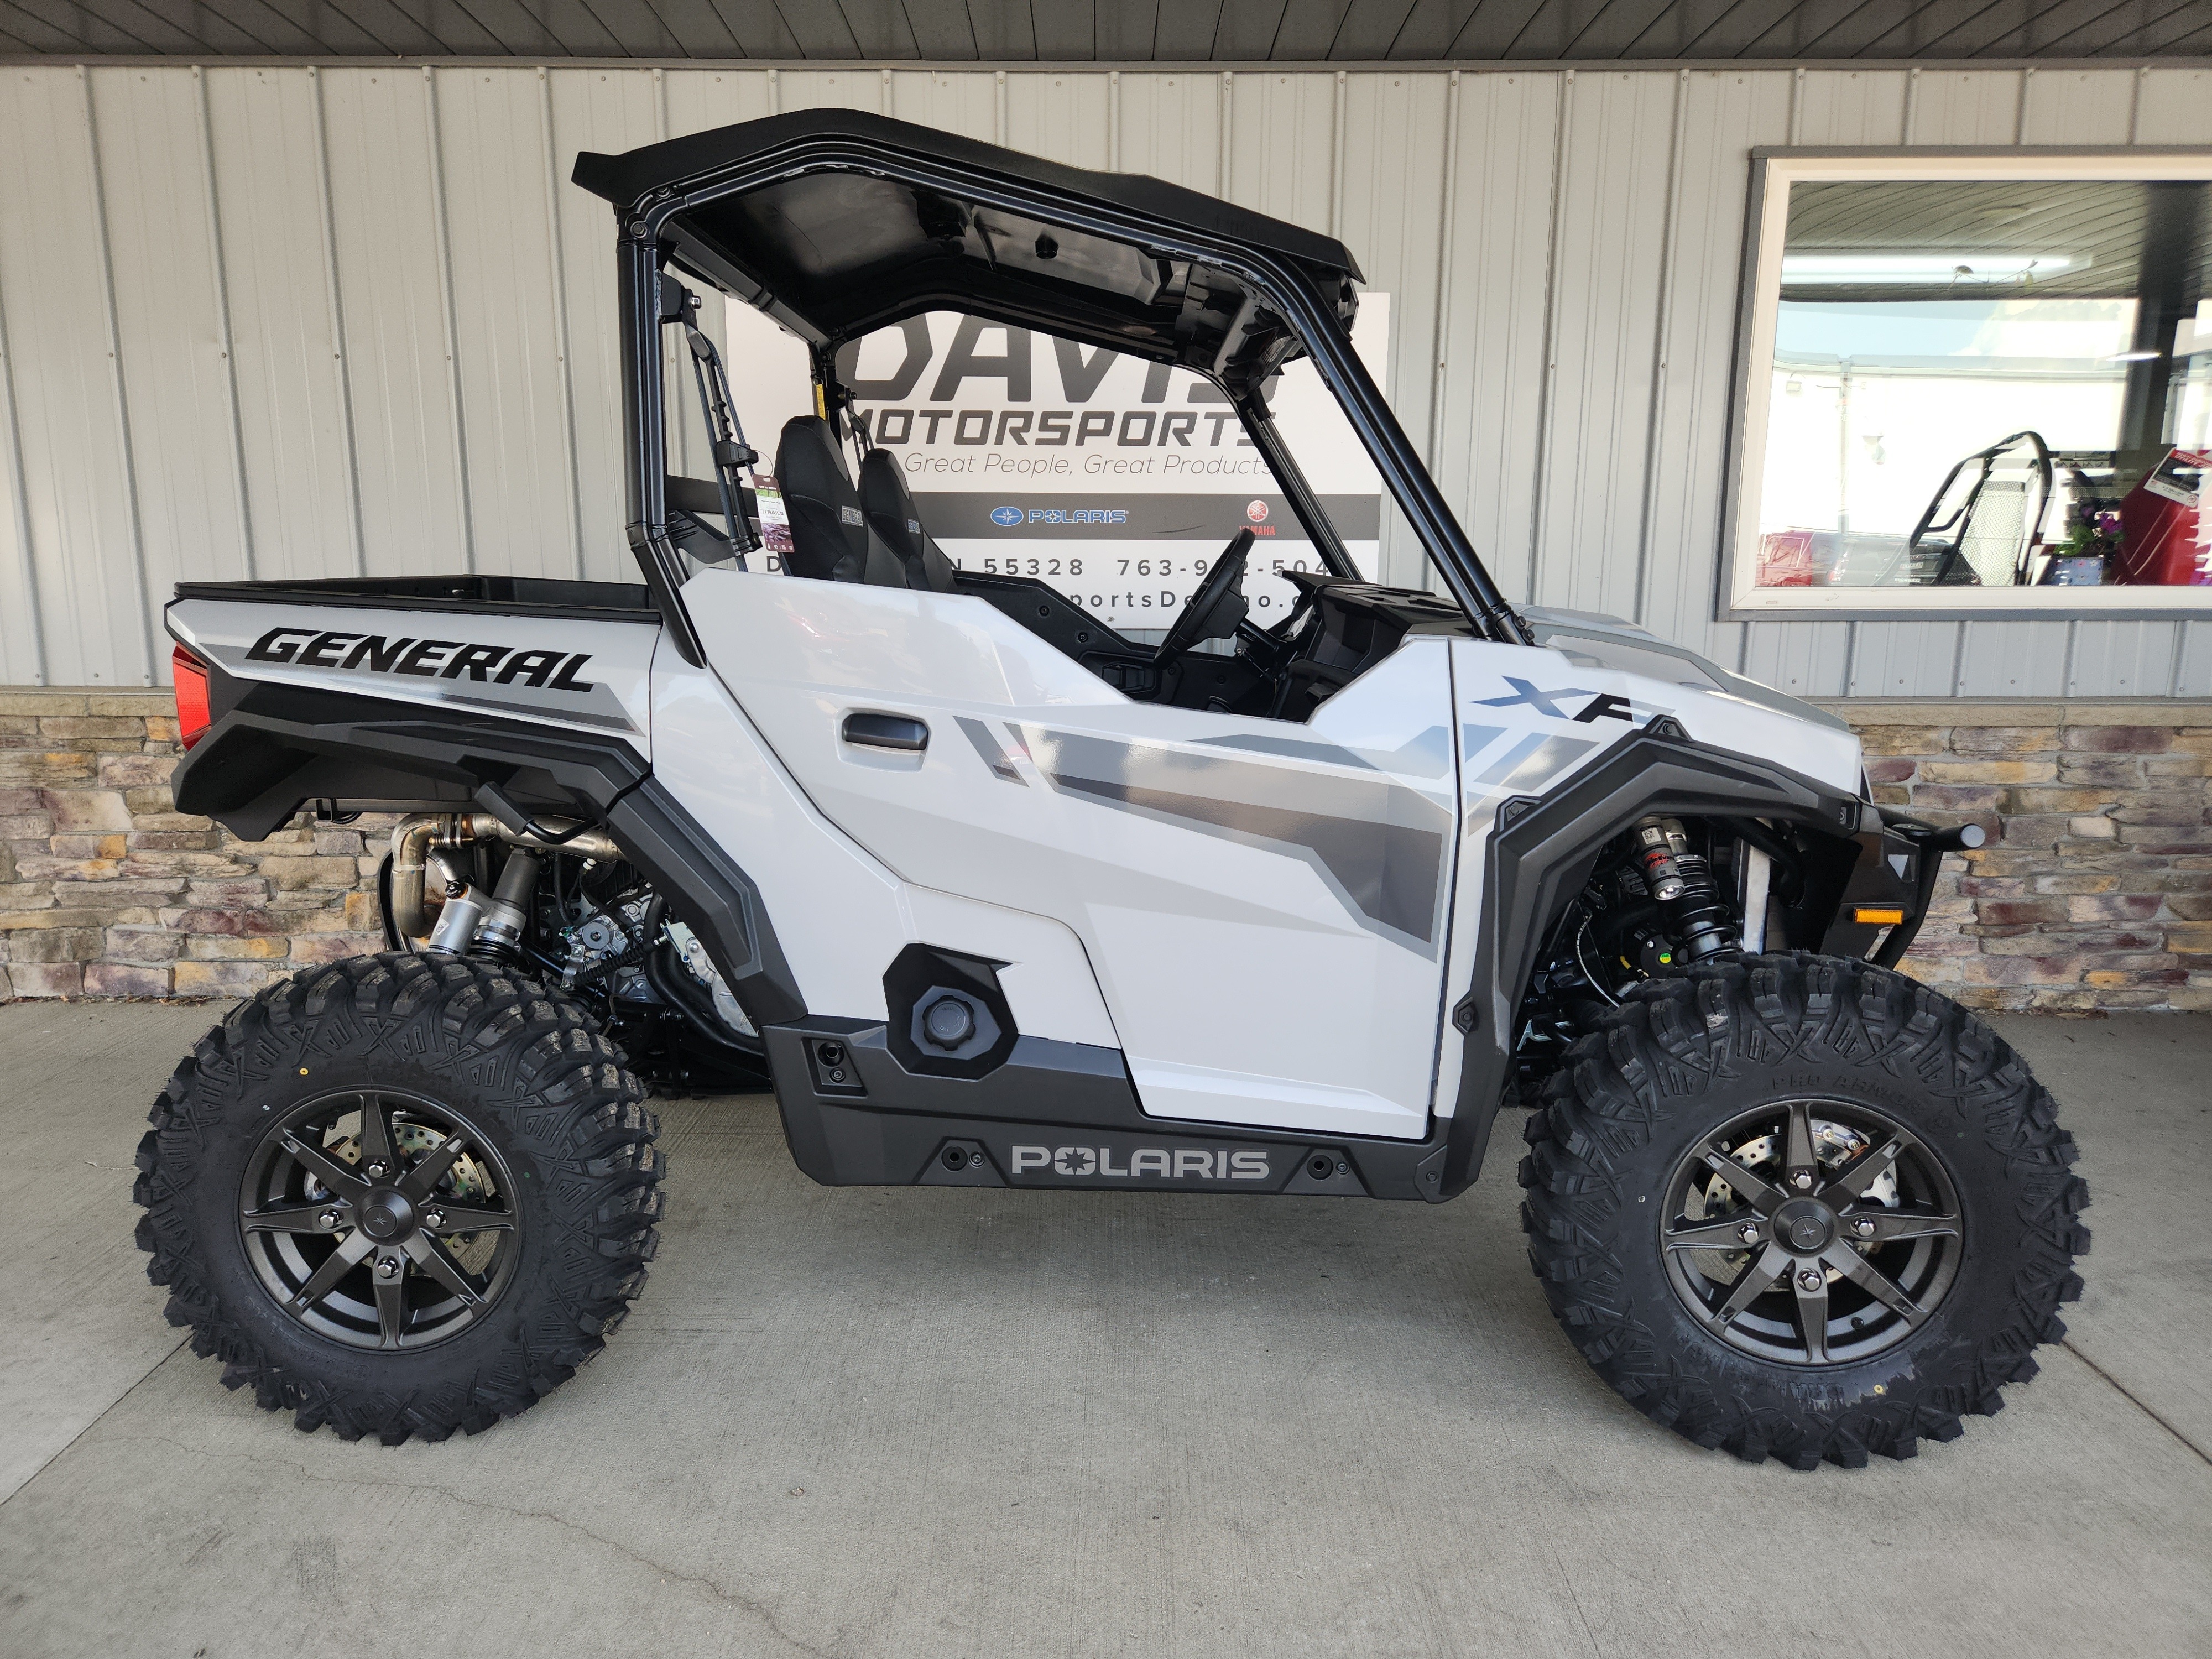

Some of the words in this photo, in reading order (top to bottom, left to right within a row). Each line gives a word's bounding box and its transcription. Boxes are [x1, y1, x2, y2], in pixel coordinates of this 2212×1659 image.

[834, 313, 1276, 403] DAV
[905, 452, 977, 474] Great
[984, 453, 1072, 479] People,
[1084, 453, 1159, 474] Great
[1162, 455, 1271, 474] Products
[1028, 509, 1126, 524] POLARIS
[1239, 525, 1276, 535] MAHA
[984, 558, 1083, 576] 55328
[245, 627, 597, 692] GENERAL
[1011, 1145, 1270, 1180] POLARIS
